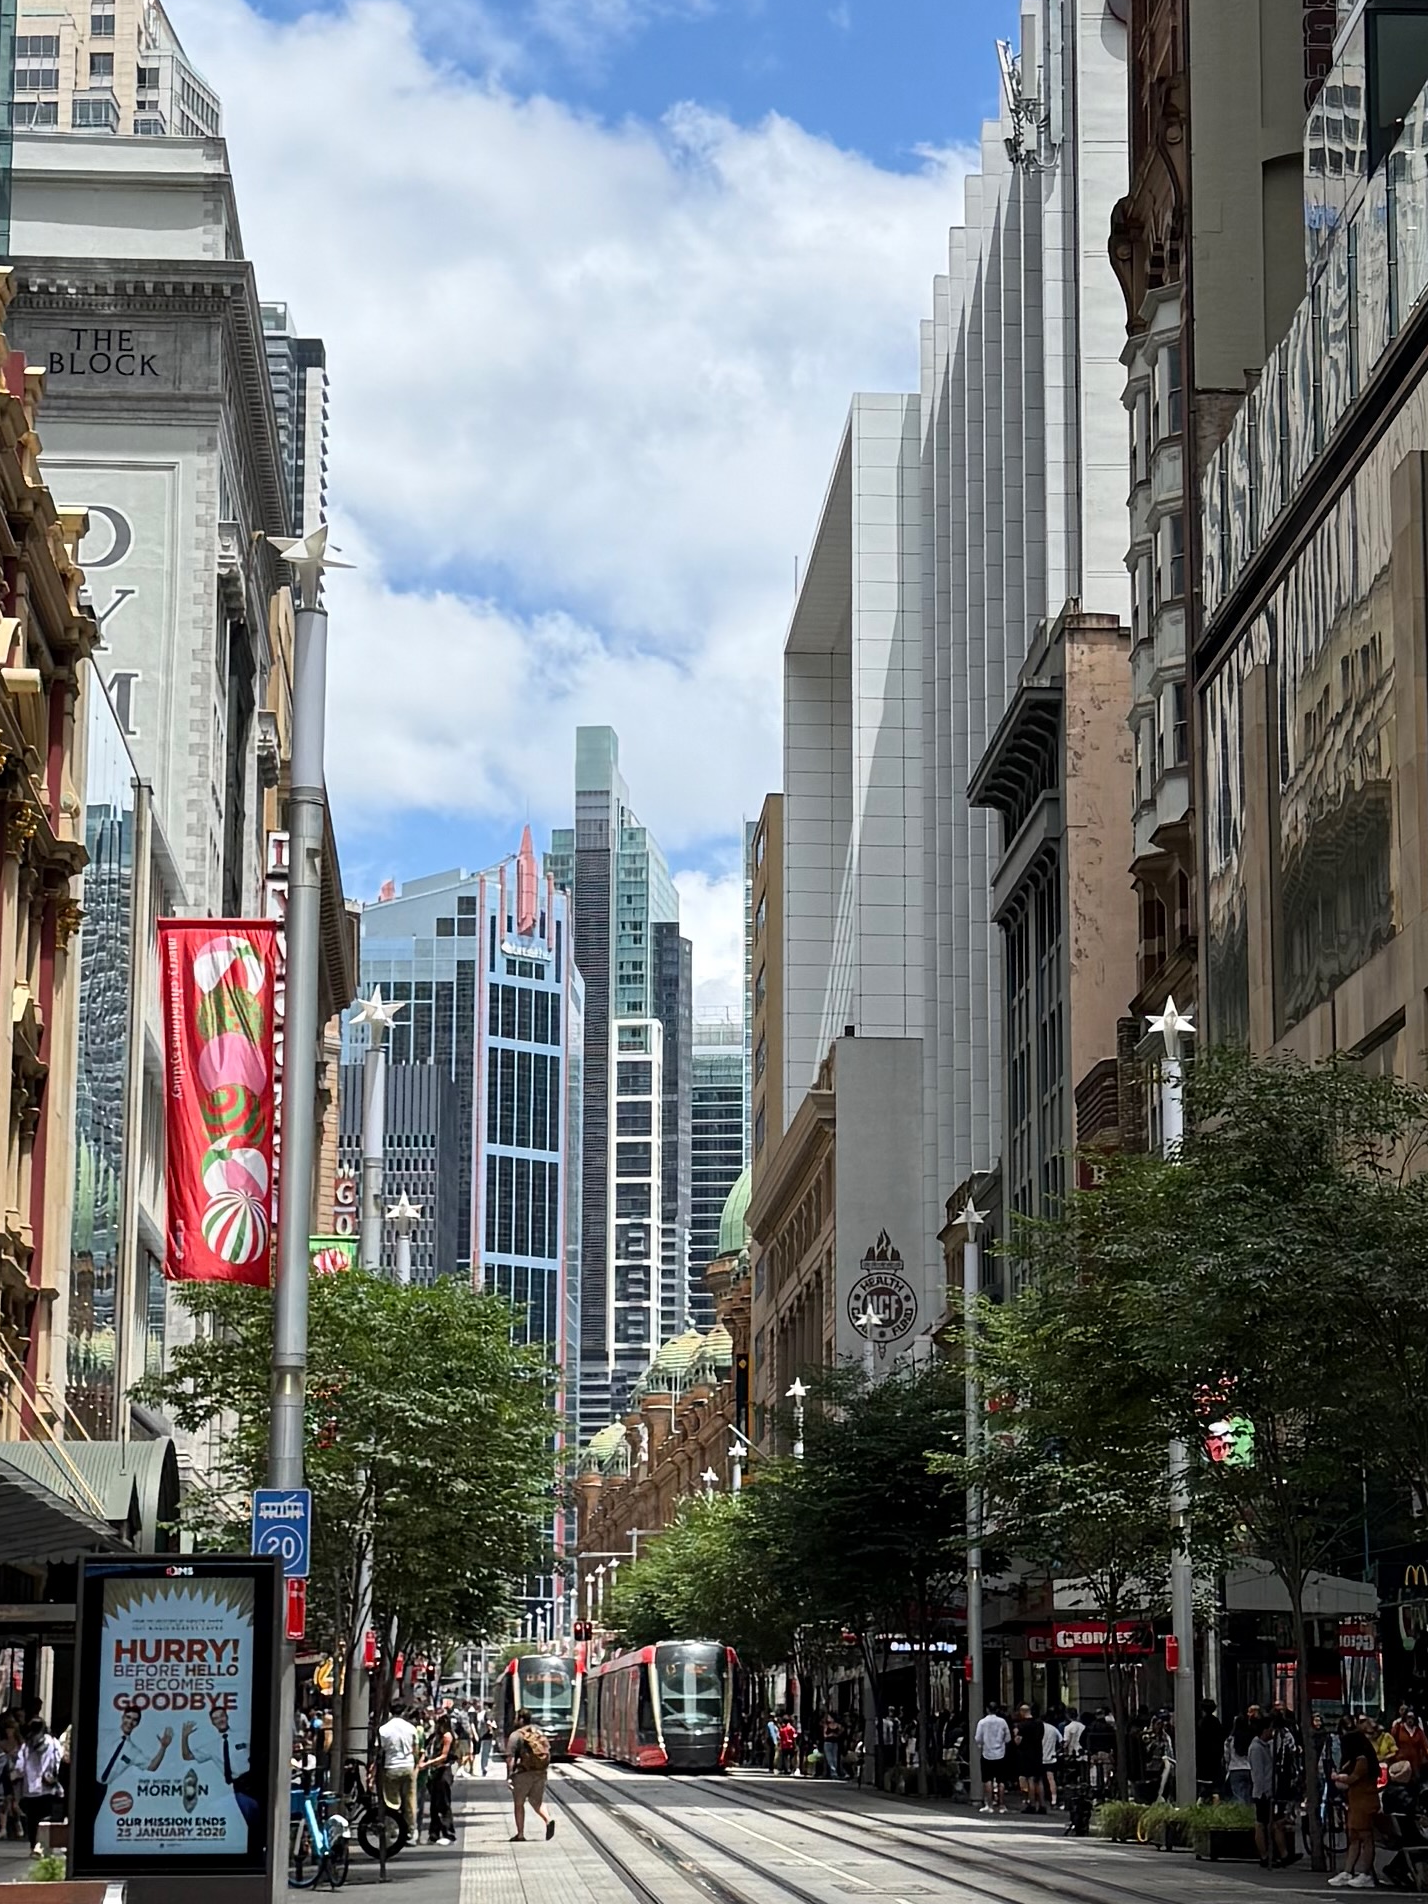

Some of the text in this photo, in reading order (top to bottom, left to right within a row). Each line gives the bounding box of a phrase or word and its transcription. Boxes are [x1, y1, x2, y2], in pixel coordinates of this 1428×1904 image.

[71, 329, 134, 352] THE
[49, 352, 160, 377] BLOCK
[859, 1275, 905, 1293] HEALTH
[891, 1308, 914, 1336] FUND
[266, 1536, 295, 1559] 20
[114, 1638, 240, 1663] HURRY!
[113, 1664, 239, 1677] BEFORE HELLO
[134, 1678, 215, 1691] BECOMES
[113, 1692, 239, 1711] GOODBYE
[116, 1817, 227, 1827] OUR MISSION ENDS
[136, 1828, 194, 1838] JANUARY
